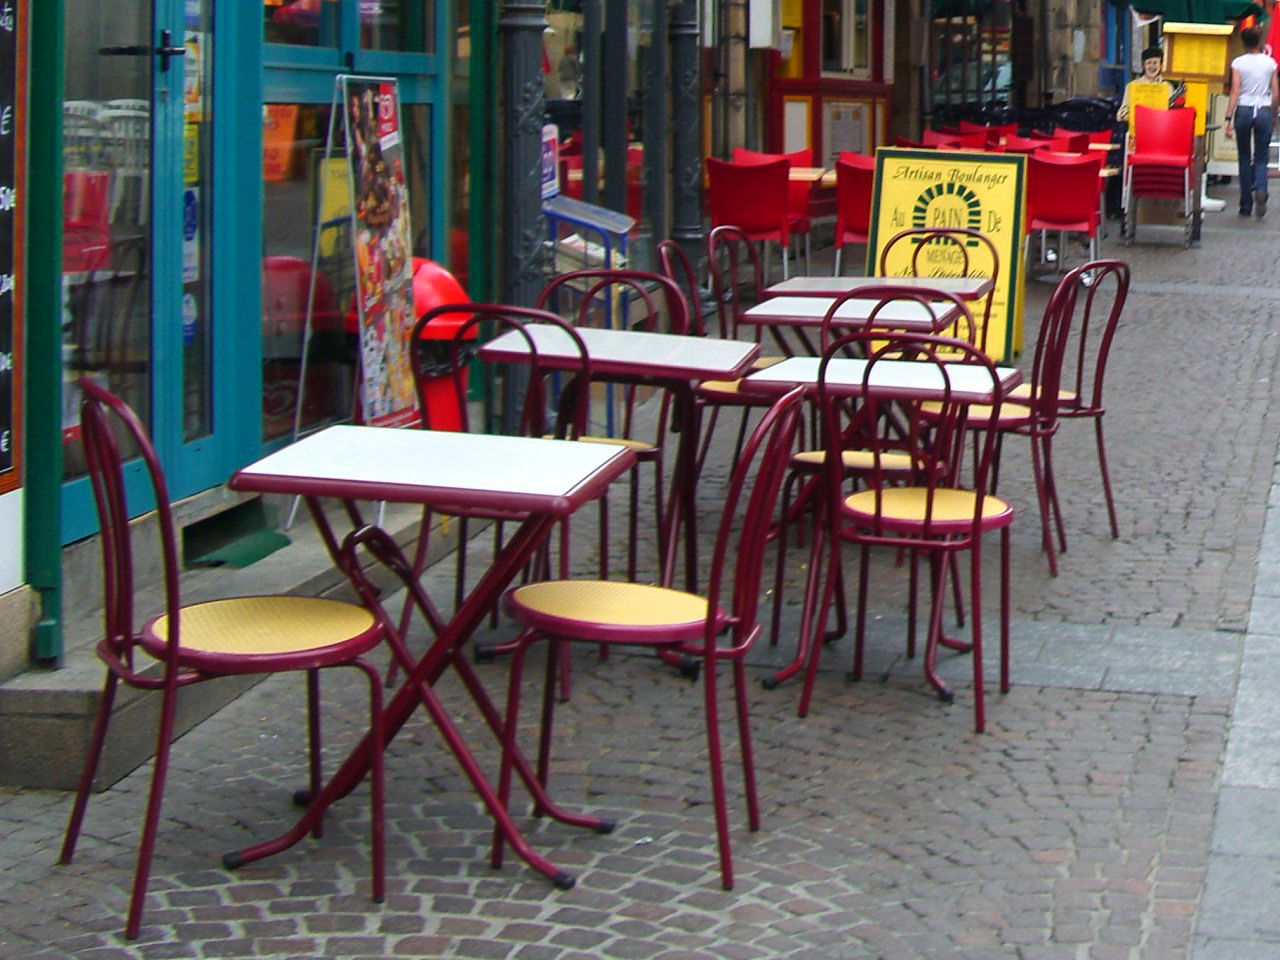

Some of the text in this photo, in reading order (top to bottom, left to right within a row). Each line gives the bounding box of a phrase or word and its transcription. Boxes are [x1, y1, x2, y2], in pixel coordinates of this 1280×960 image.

[892, 164, 1010, 190] Artisan Boulanger
[890, 207, 1002, 233] Au PAIN De
